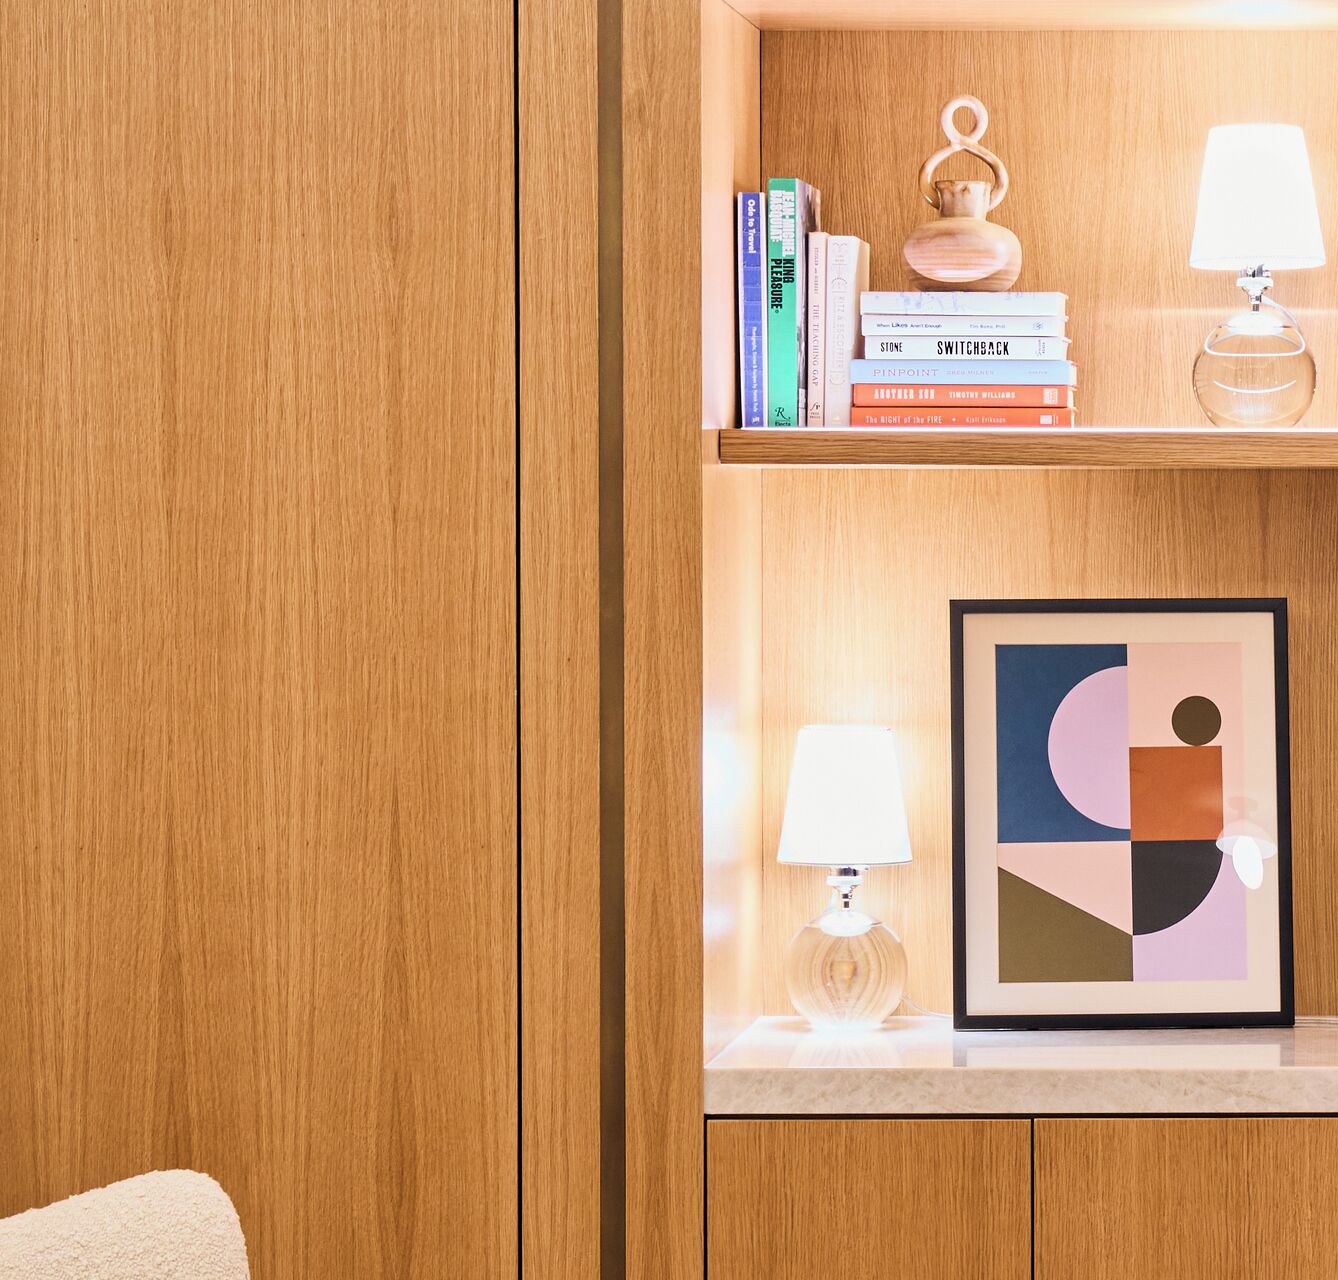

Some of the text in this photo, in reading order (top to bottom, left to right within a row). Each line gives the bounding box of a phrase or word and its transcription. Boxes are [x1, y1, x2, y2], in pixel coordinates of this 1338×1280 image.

[747, 199, 757, 254] Ode to Travel
[782, 191, 795, 257] JEAN-MICHEL
[783, 258, 795, 284] KING
[880, 341, 903, 353] STONE
[937, 340, 1010, 356] SWITCHBACK
[811, 369, 819, 387] GAP
[873, 368, 939, 377] PINPOINT
[874, 388, 935, 400] ANOTHER SUN
[948, 391, 1016, 400] TIMOTHY WILLIAMS
[865, 415, 943, 424] The NIGHT of the FIRE
